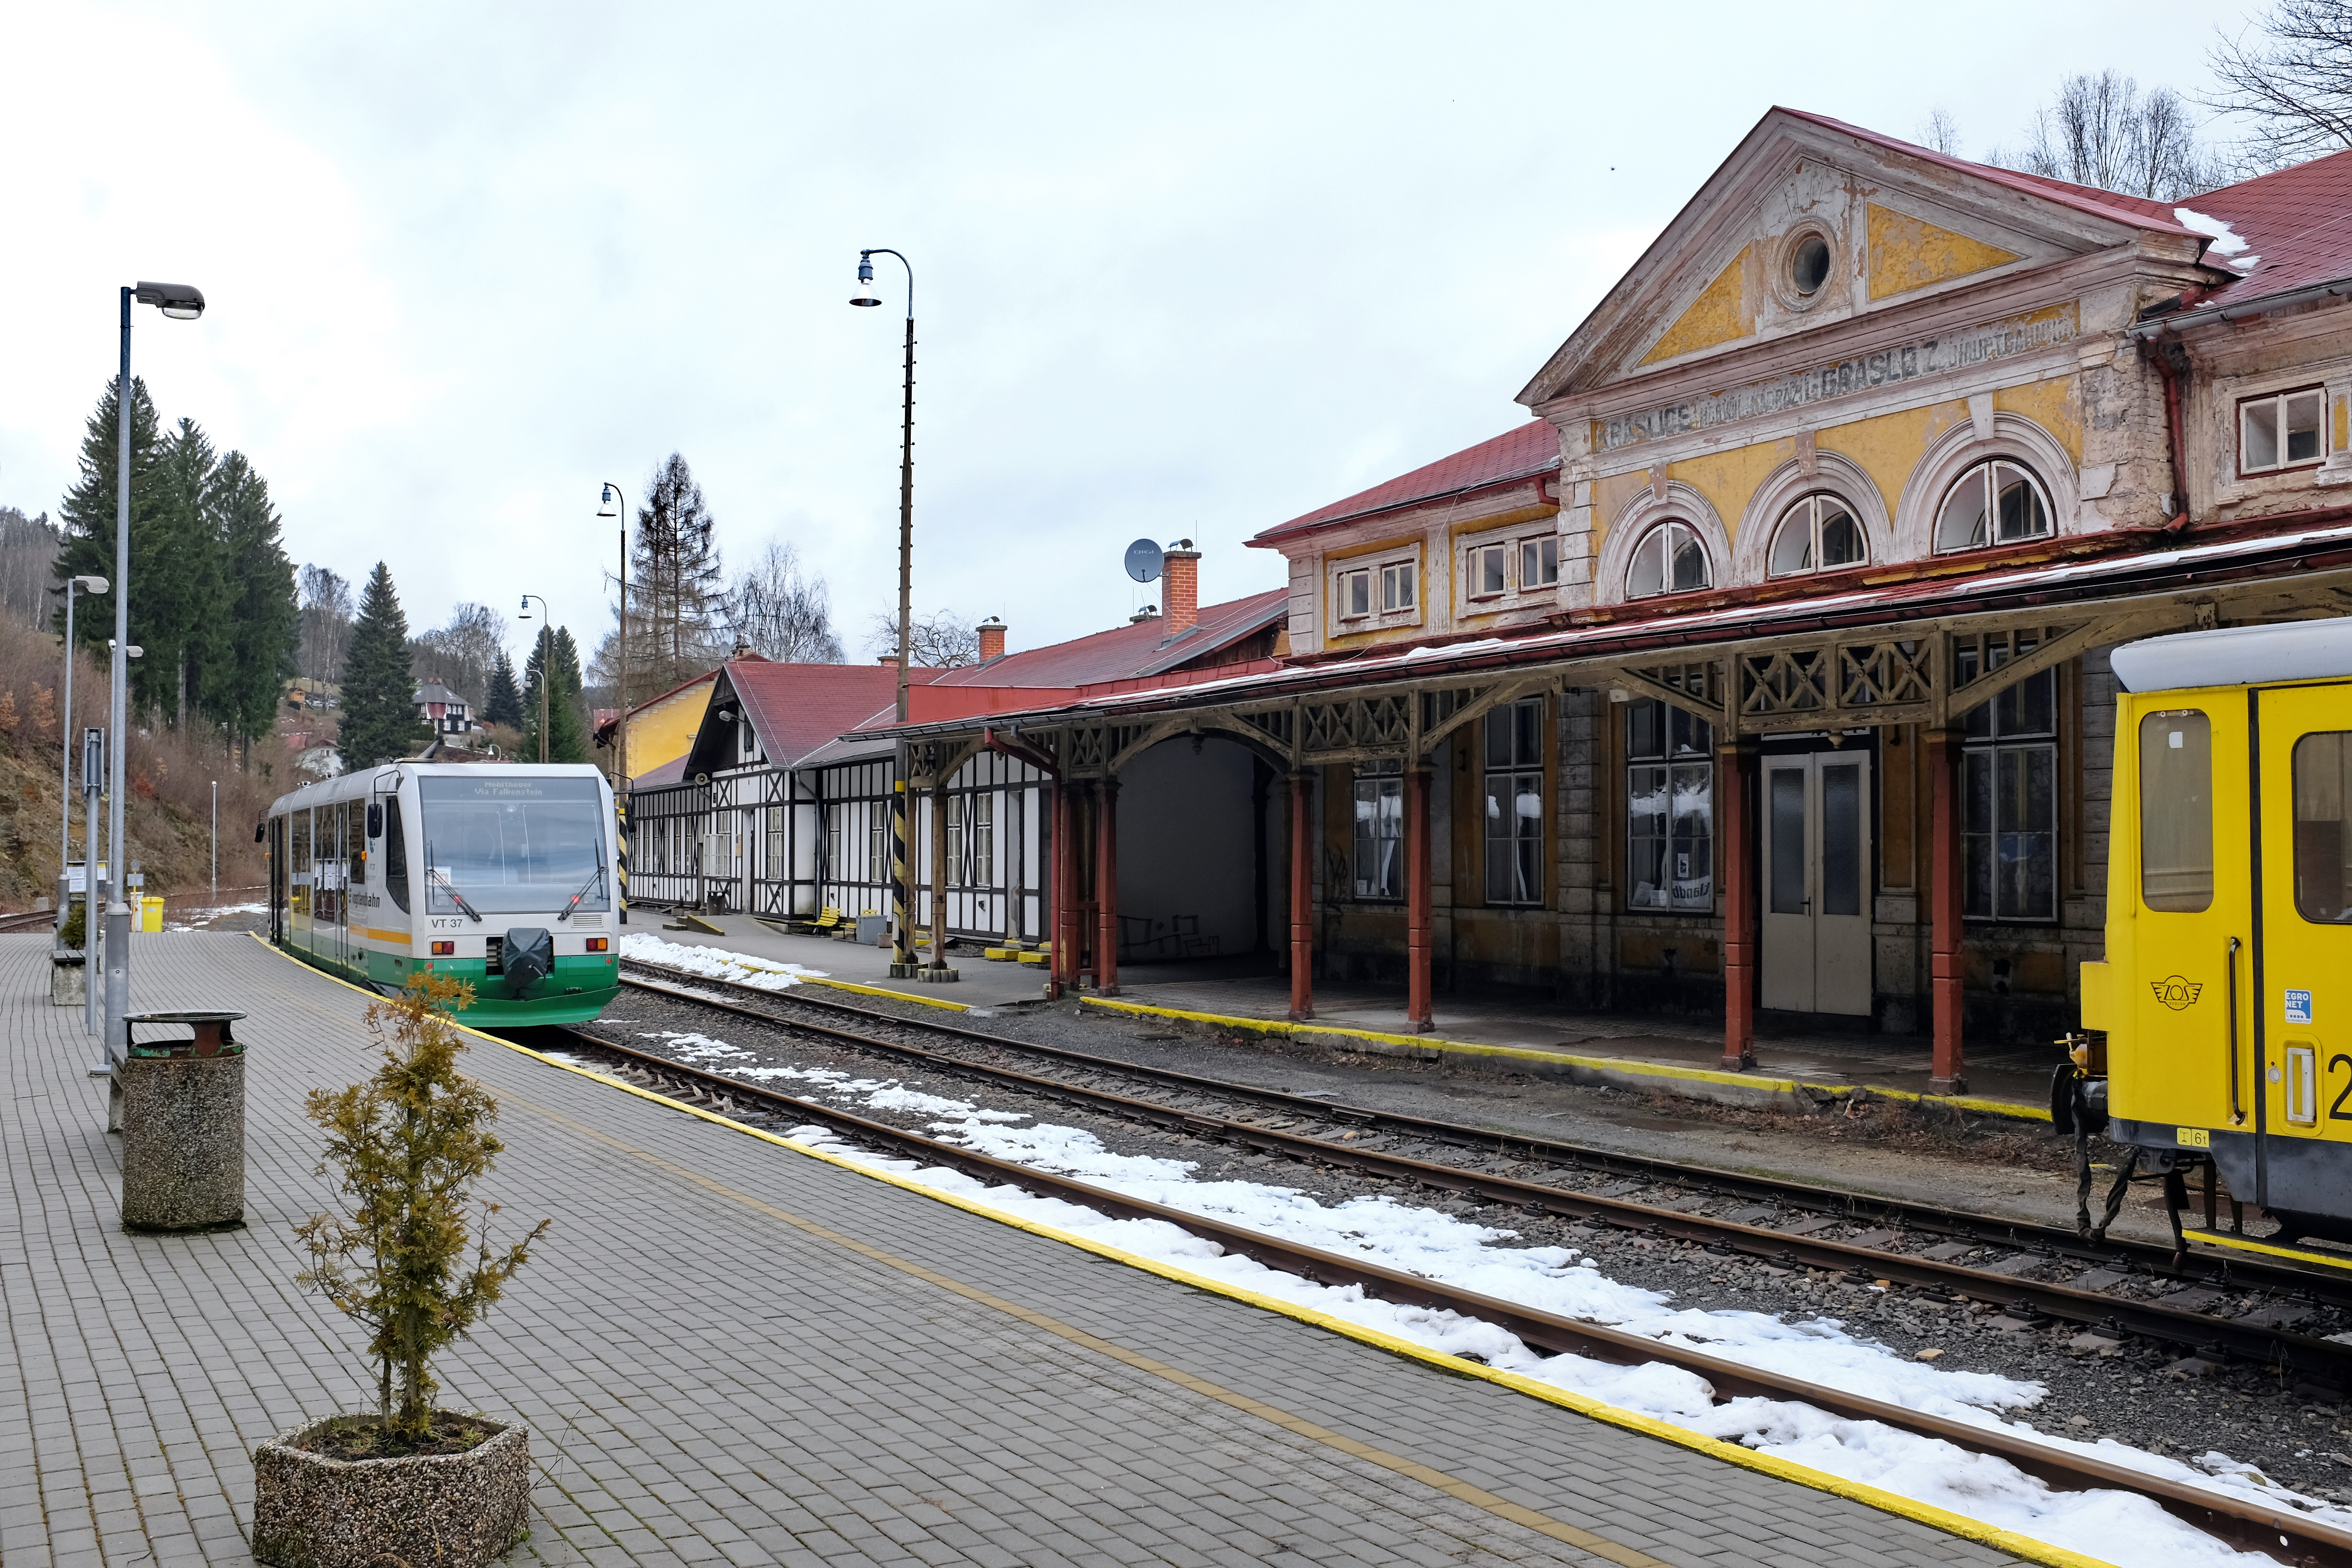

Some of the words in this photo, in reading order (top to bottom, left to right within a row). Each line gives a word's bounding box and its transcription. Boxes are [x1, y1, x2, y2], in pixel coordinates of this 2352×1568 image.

[352, 891, 380, 908] vogtlandbahn
[431, 919, 447, 928] VT
[450, 919, 463, 928] 37
[2286, 992, 2309, 1001] EGRO
[2286, 1000, 2303, 1008] NET
